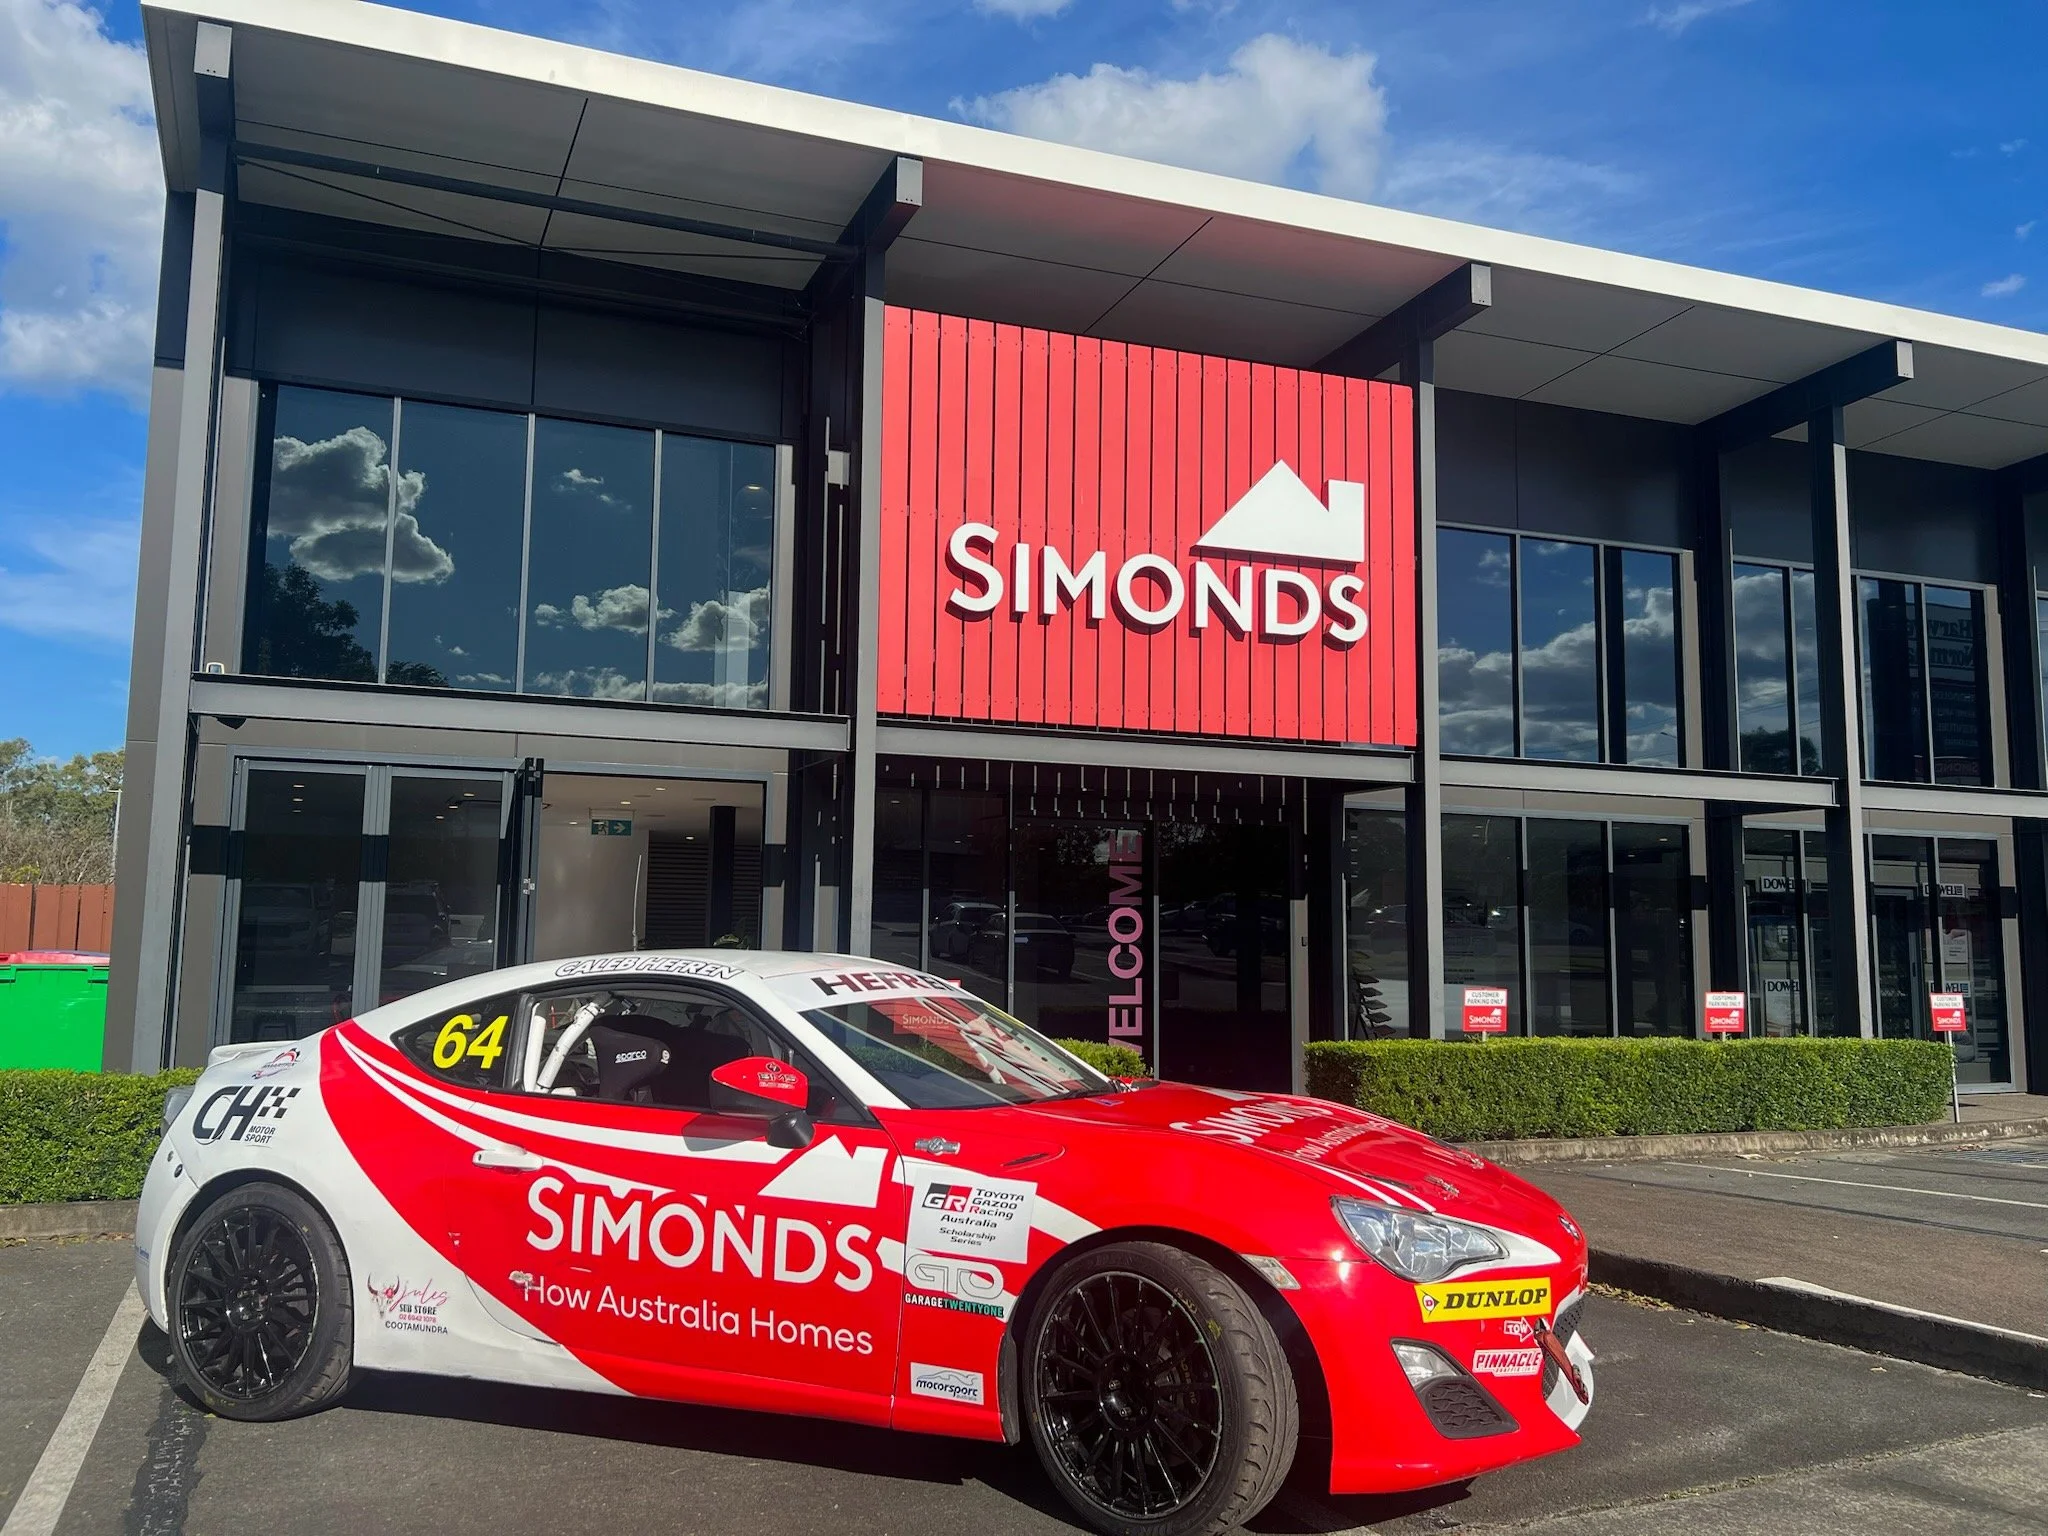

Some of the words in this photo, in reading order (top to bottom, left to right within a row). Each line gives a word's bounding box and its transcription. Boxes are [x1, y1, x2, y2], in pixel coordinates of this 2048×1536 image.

[947, 522, 1369, 646] SIMONDS
[555, 956, 640, 977] CALEB
[637, 956, 744, 980] HEFREN
[1469, 1014, 1502, 1024] SIMONDS
[433, 1014, 508, 1069] 64
[193, 1086, 274, 1141] CH
[248, 1125, 277, 1135] MOTOR
[244, 1133, 272, 1144] SPORT
[922, 1193, 966, 1212] GR
[975, 1189, 1025, 1202] TOYOTA
[971, 1197, 1018, 1210] GAZOO
[969, 1205, 1014, 1220] Racing
[940, 1214, 998, 1228] Australia
[526, 1176, 873, 1292] SIMONDS
[939, 1227, 996, 1242] Scholarship
[950, 1236, 982, 1246] Series
[1443, 1287, 1548, 1310] DUNLOP
[399, 1304, 412, 1313] SUB
[414, 1305, 437, 1315] STORE
[523, 1276, 592, 1311] How
[597, 1285, 740, 1335] Australia
[751, 1307, 874, 1355] Homes
[385, 1320, 449, 1334] COOTAMUNDRA
[1507, 1322, 1529, 1334] TOW
[1476, 1351, 1542, 1369] PINNACLE
[916, 1379, 978, 1398] motorsport
